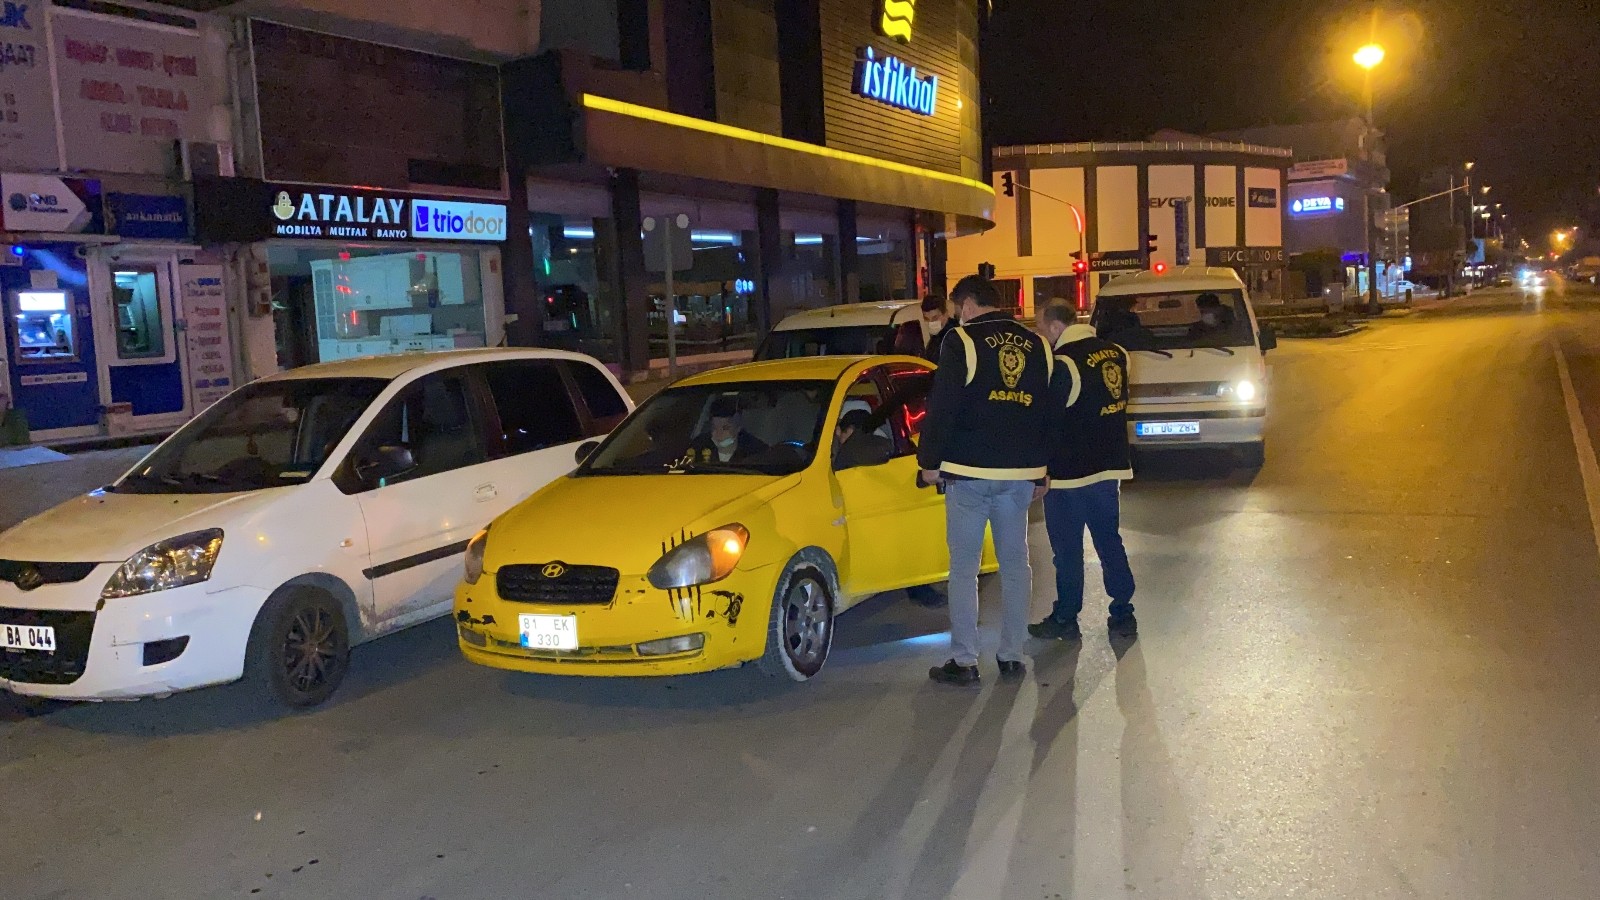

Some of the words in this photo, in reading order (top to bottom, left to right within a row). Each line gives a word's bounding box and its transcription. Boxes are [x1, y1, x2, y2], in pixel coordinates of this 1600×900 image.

[863, 45, 938, 116] istikbal
[297, 193, 404, 224] ATALAY
[433, 209, 503, 235] triodoor
[329, 226, 368, 237] MUTFAK
[376, 229, 408, 239] BANYO
[988, 390, 1033, 407] ASAYİŞ
[523, 617, 537, 630] 81
[553, 618, 569, 631] EK
[7, 626, 22, 646] BA
[28, 627, 52, 646] 044
[537, 633, 560, 647] 330
